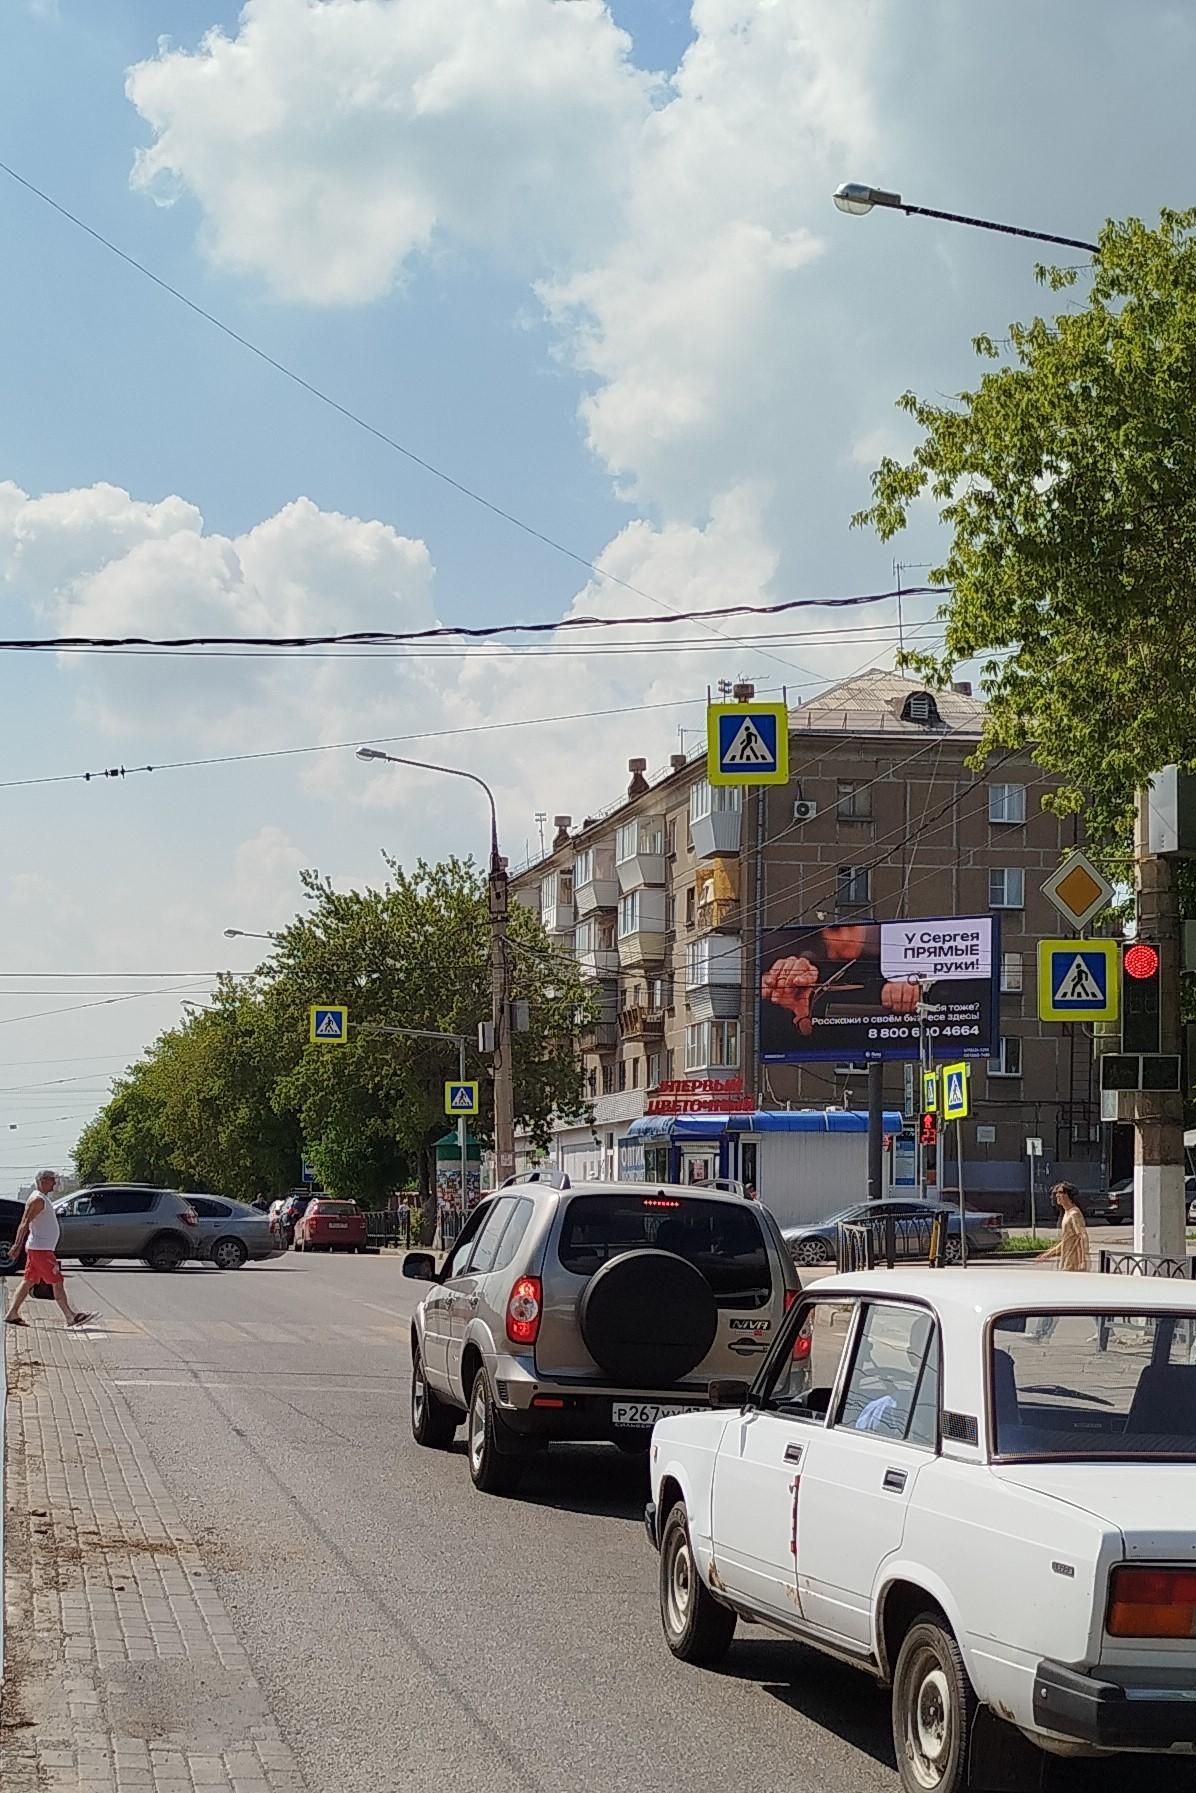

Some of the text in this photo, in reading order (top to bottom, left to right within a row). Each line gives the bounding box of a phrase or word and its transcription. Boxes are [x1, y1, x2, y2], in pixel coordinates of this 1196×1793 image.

[904, 931, 980, 945] У Сергея
[903, 943, 980, 959] ПРЯМЫЕ
[933, 958, 980, 975] руки!
[949, 1002, 980, 1013] тоже?
[811, 1016, 862, 1026] Расскажи
[870, 1014, 902, 1024] своём
[868, 1028, 878, 1039] 8
[880, 1027, 909, 1039] 800
[941, 1025, 980, 1037] 4664
[732, 1320, 769, 1330] NIVA
